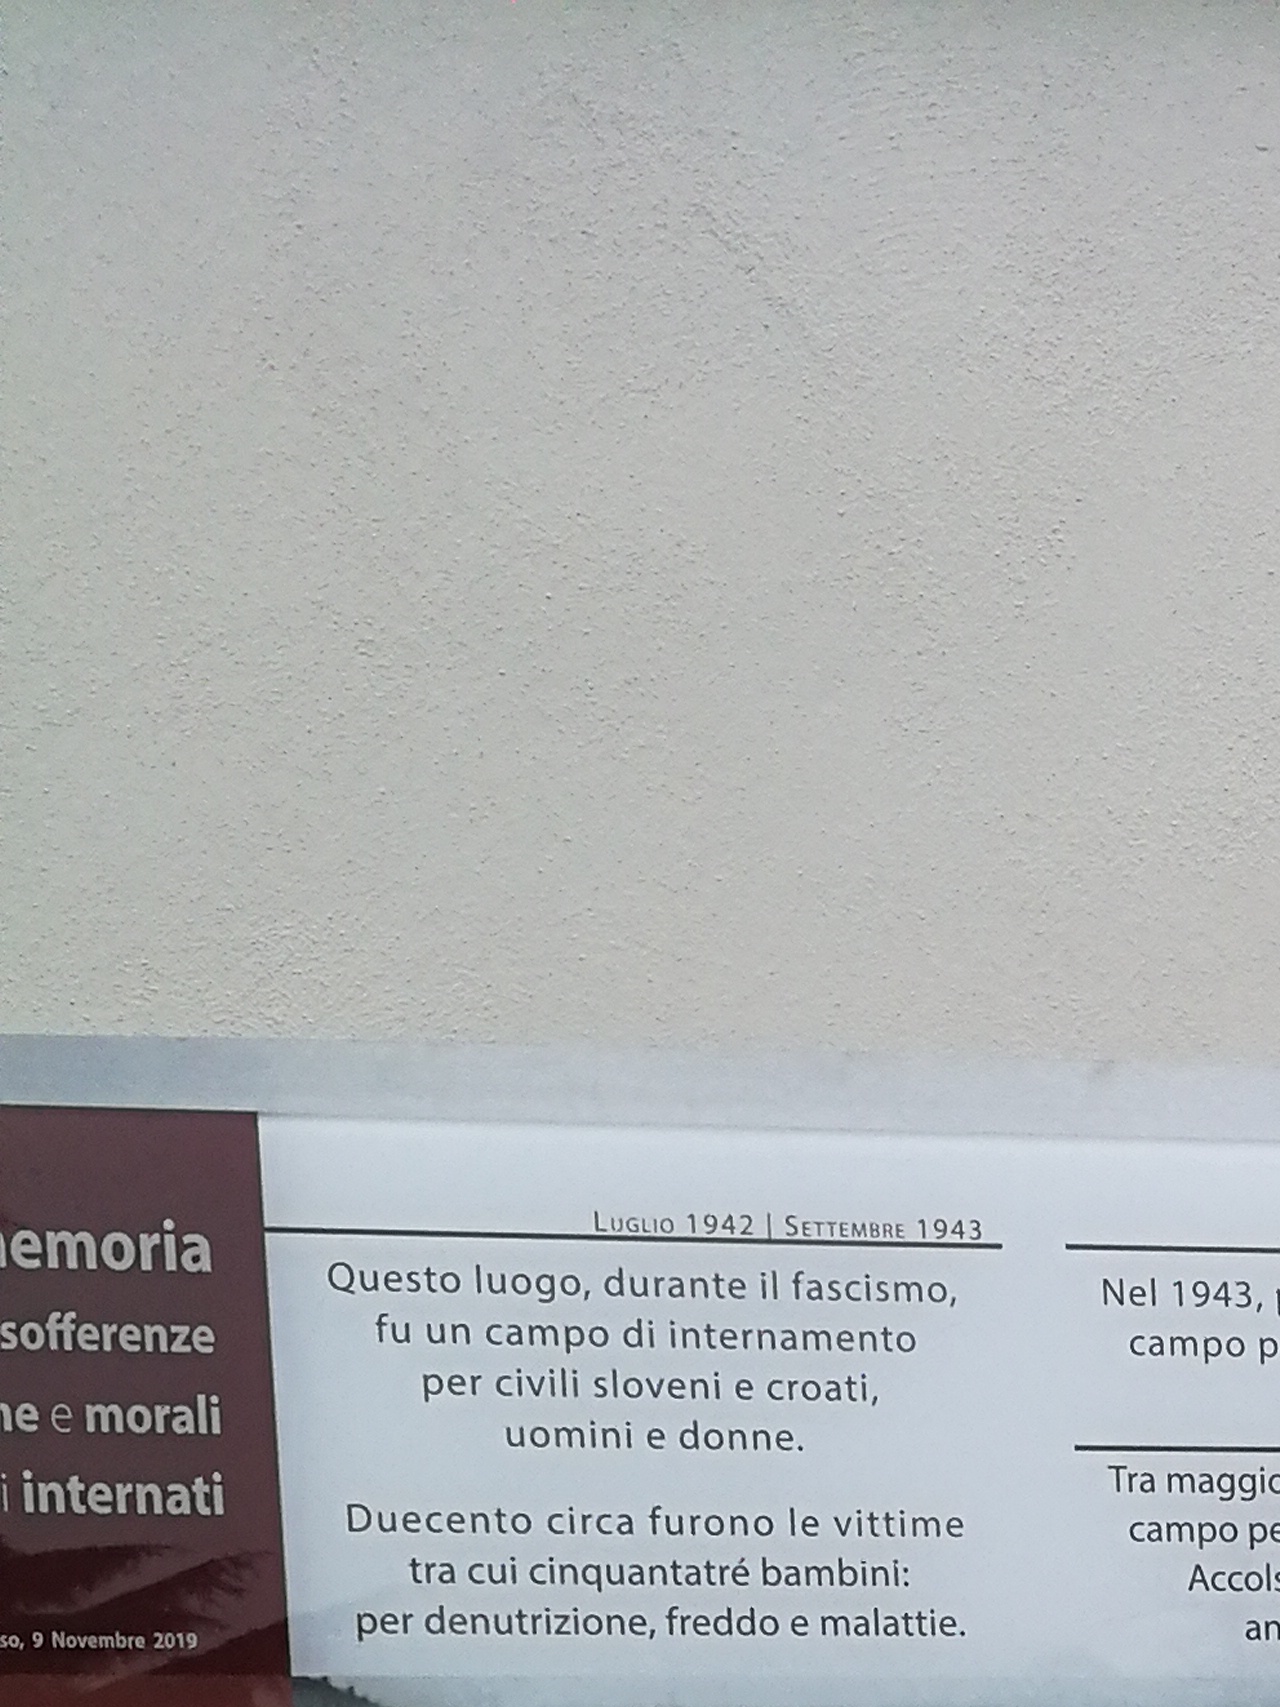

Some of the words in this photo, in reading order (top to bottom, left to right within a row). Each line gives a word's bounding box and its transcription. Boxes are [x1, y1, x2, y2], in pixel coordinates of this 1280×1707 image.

[0, 1218, 213, 1273] emoria
[687, 1213, 754, 1235] 1942
[917, 1218, 982, 1241] 1943
[327, 1261, 461, 1295] Questo
[475, 1263, 591, 1304] luogo,
[604, 1266, 747, 1300] durante
[760, 1270, 778, 1300] il
[791, 1269, 957, 1308] fascismo,
[1102, 1277, 1157, 1307] Nel
[1172, 1280, 1263, 1313] 1943,
[0, 1312, 216, 1354] sofferenze
[375, 1312, 411, 1344] fu
[426, 1323, 471, 1345] un
[485, 1323, 610, 1355] campo
[623, 1317, 655, 1349] di
[669, 1319, 917, 1353] internamento
[1129, 1334, 1246, 1365] campo
[422, 1373, 483, 1404] per
[495, 1367, 579, 1398] civili
[593, 1367, 721, 1401] sloveni
[735, 1379, 754, 1401] e
[767, 1373, 878, 1407] croati,
[50, 1403, 73, 1433] e
[85, 1393, 221, 1435] morali
[505, 1420, 633, 1449] uomini
[646, 1427, 666, 1450] e
[679, 1419, 804, 1452] donne.
[22, 1469, 225, 1516] internati
[1107, 1464, 1156, 1494] Tra
[346, 1503, 532, 1535] Duecento
[547, 1506, 634, 1536] circa
[648, 1505, 774, 1537] furono
[789, 1507, 820, 1538] le
[833, 1508, 964, 1538] vittime
[1129, 1521, 1239, 1550] campo
[409, 1557, 456, 1585] tra
[467, 1556, 517, 1585] cui
[528, 1556, 750, 1593] cinquantatré
[761, 1556, 910, 1588] bambini:
[32, 1631, 44, 1648] 9
[51, 1630, 146, 1650] Novembre
[153, 1631, 198, 1649] 2019
[356, 1612, 414, 1643] per
[424, 1604, 656, 1641] denutrizione,
[665, 1605, 780, 1637] freddo
[790, 1614, 809, 1637] e
[820, 1606, 966, 1638] malattie.
